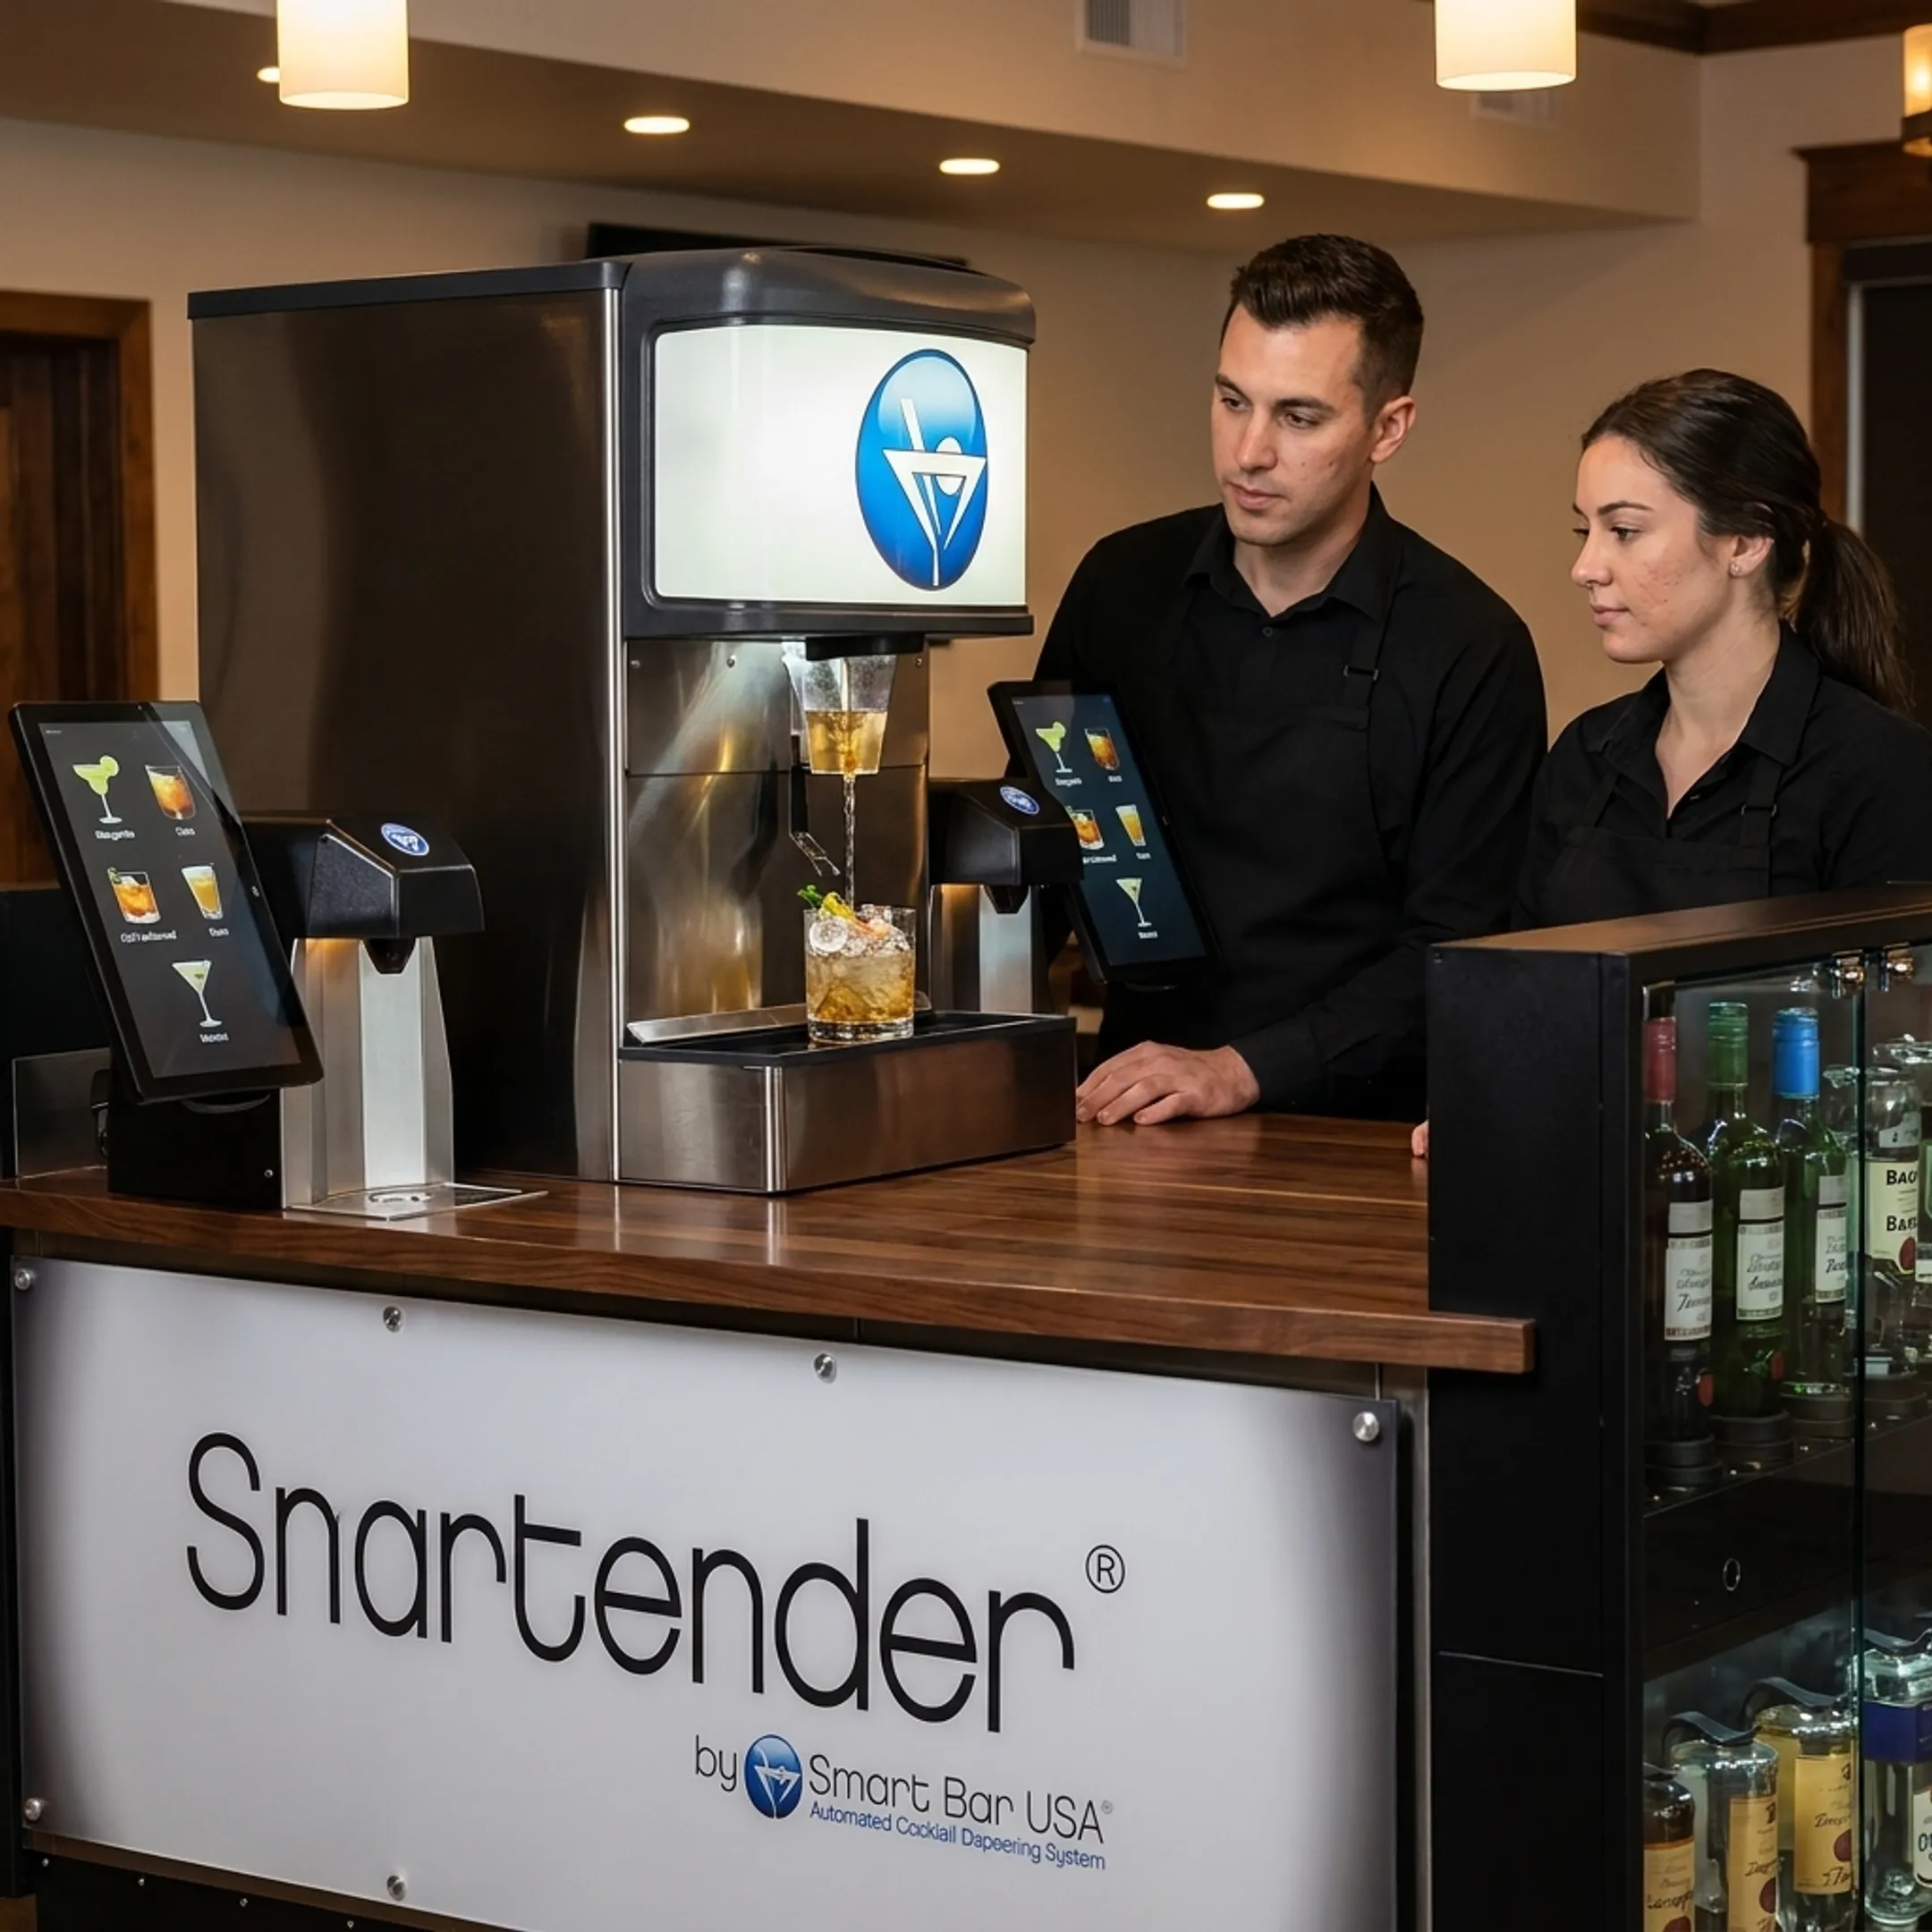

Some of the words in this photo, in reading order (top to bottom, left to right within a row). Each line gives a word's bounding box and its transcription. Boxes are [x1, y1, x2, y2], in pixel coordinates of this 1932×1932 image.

[696, 1735, 737, 1792] by
[809, 1754, 929, 1812] Smart
[943, 1777, 1014, 1826] Bar
[809, 1801, 892, 1832] Automated
[1045, 1843, 1106, 1870] System
